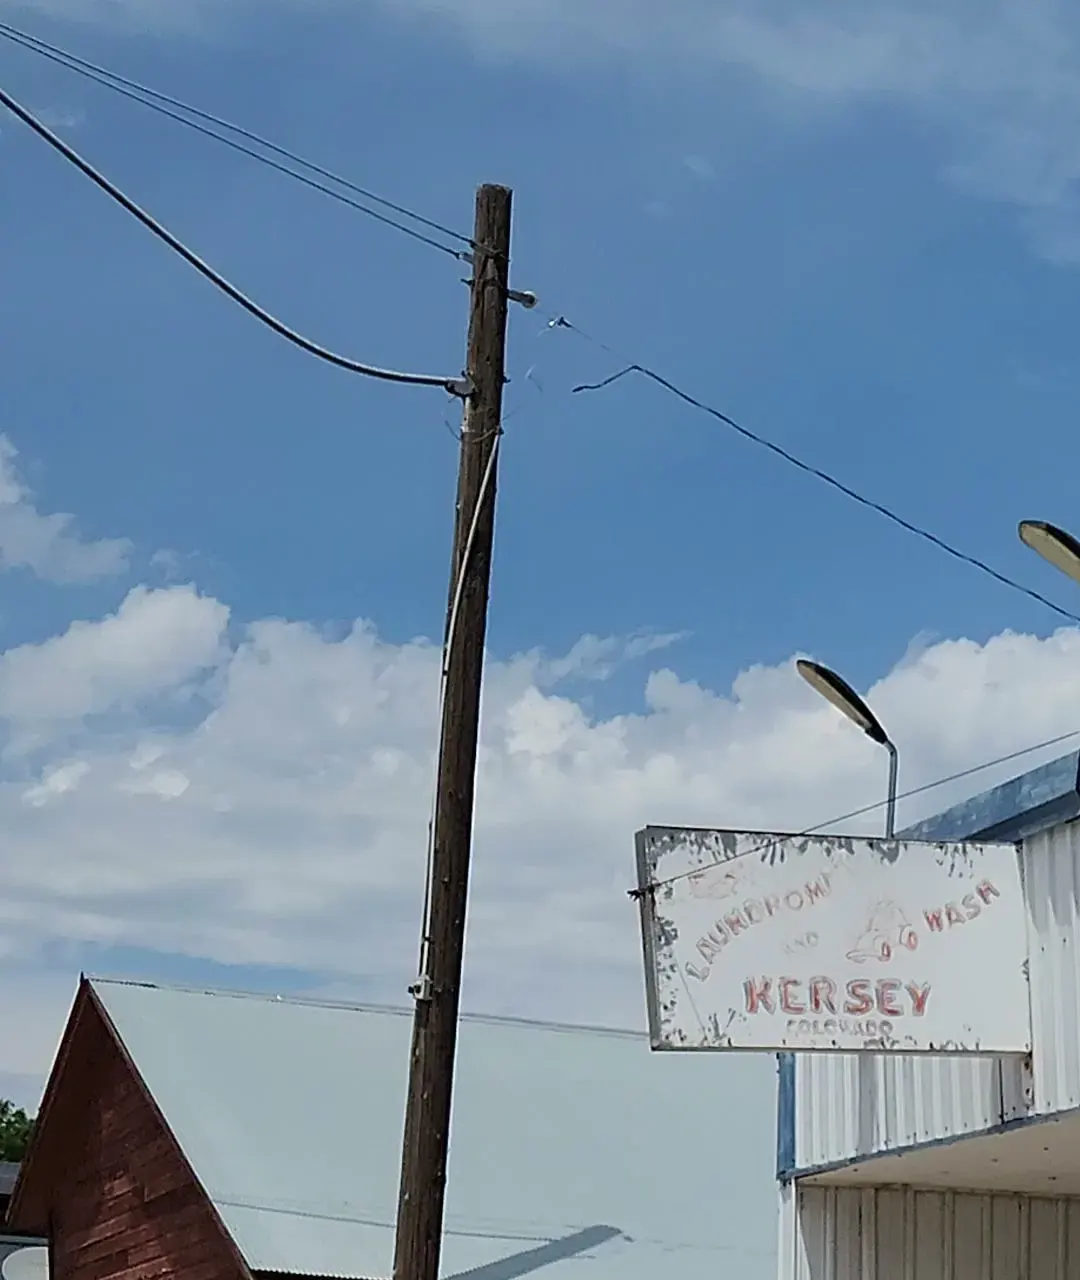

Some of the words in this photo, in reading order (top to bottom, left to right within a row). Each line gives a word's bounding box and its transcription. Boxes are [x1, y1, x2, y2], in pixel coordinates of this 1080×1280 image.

[684, 854, 851, 982] LAUNDROMT
[923, 879, 1000, 934] WASH
[743, 975, 931, 1017] KERSEY
[786, 1019, 893, 1037] COLORADO
